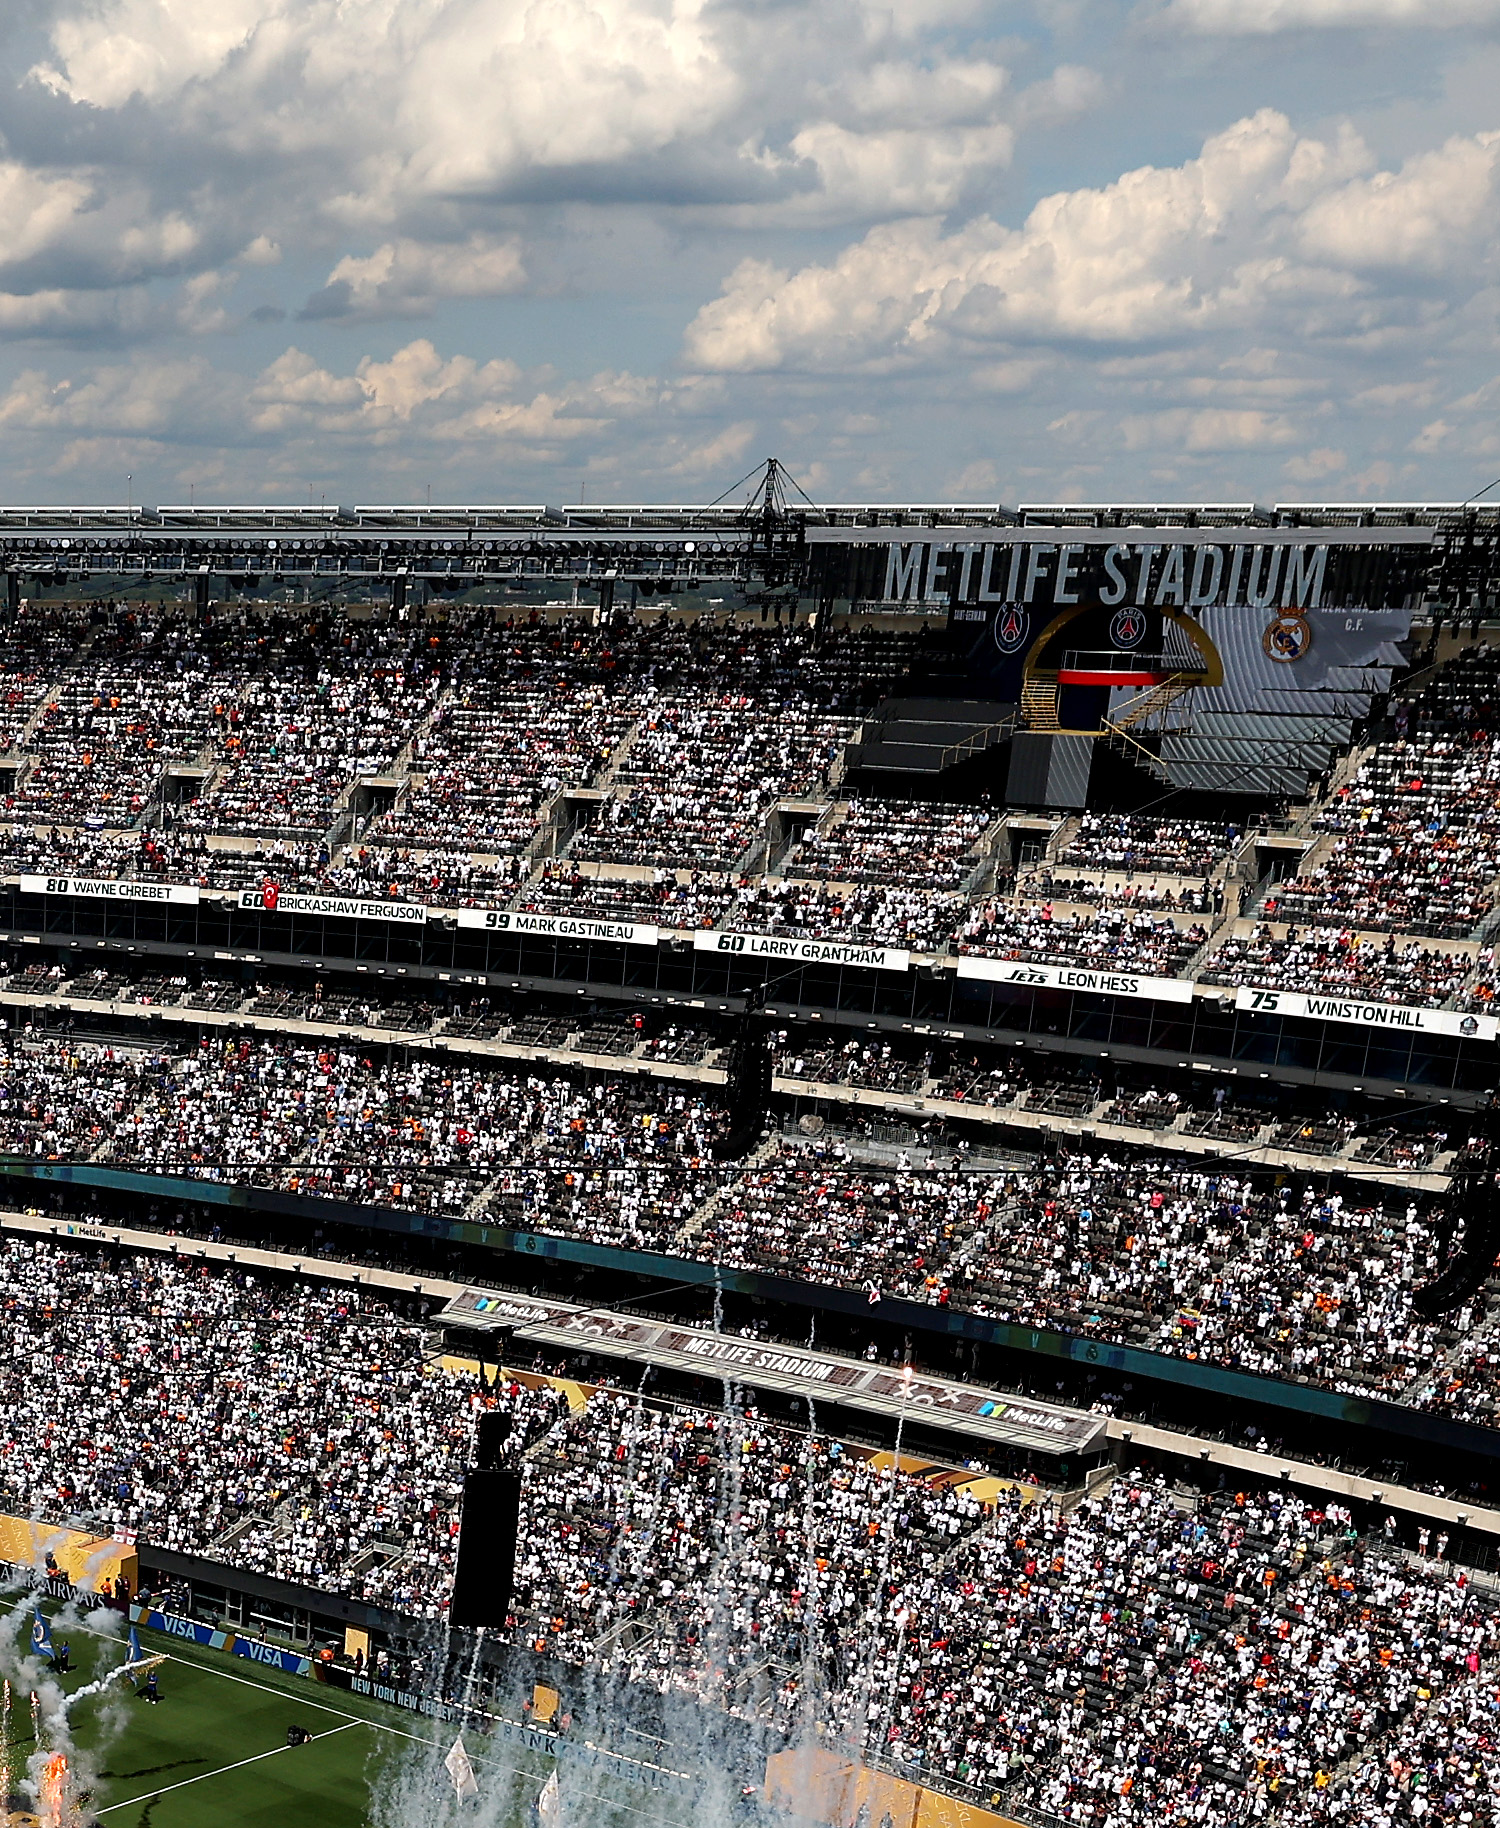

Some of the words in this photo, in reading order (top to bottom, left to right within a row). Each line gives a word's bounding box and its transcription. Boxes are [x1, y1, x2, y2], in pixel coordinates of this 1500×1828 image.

[884, 543, 1085, 605] METLIFE
[1098, 543, 1331, 608] STADIUM
[46, 878, 69, 893] 80
[73, 882, 117, 896] WAYNE
[118, 884, 172, 900] CHREBET
[242, 893, 264, 908] 60
[360, 904, 423, 920] FERGUSON
[485, 913, 510, 929] 99
[516, 917, 556, 933] MARK
[559, 920, 634, 940] GASTINEAU
[717, 934, 745, 951] 60
[751, 939, 798, 956] LARRY
[800, 943, 886, 965] GRANTHAM
[1057, 971, 1098, 988] LEON
[1099, 976, 1139, 993] HESS
[1250, 991, 1280, 1011] 75
[1307, 998, 1387, 1023] WINSTON
[1388, 1010, 1424, 1028] HILL
[79, 1227, 106, 1239] MetLife
[496, 1302, 549, 1321] MetLife
[684, 1337, 753, 1365] METLIFE
[754, 1352, 835, 1381] STADIUM
[1003, 1407, 1067, 1431] MetLife
[162, 1614, 197, 1640] VISA
[248, 1643, 284, 1668] VISA
[350, 1675, 370, 1692] NEW
[372, 1682, 396, 1702] YORK
[397, 1690, 418, 1710] NEW
